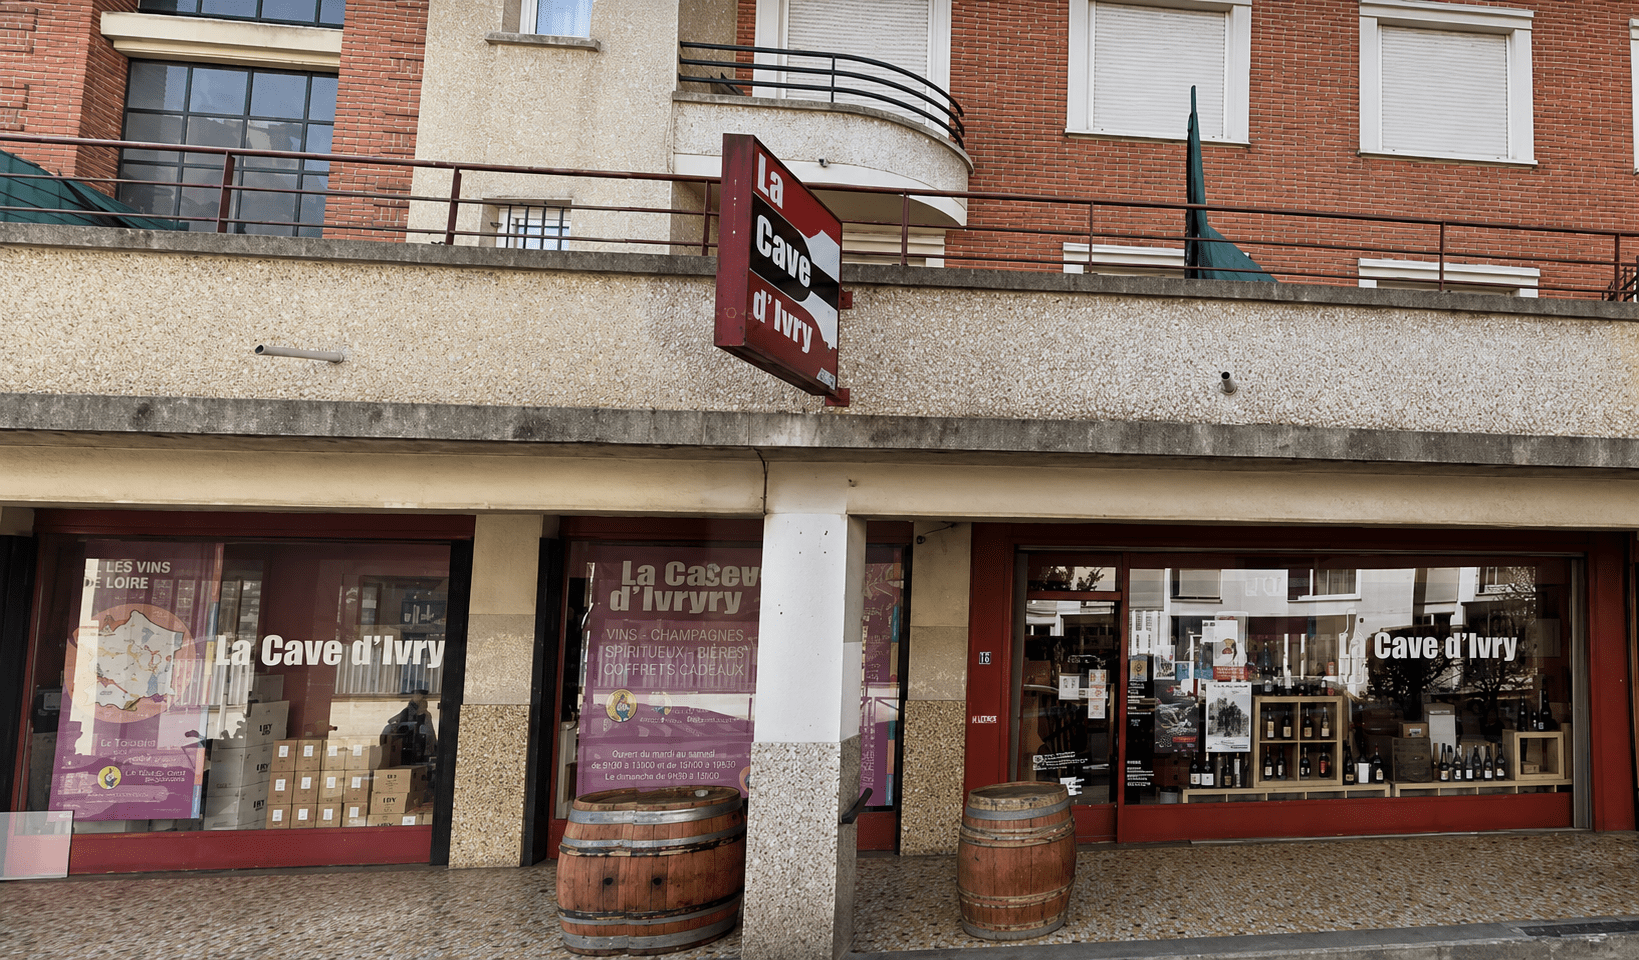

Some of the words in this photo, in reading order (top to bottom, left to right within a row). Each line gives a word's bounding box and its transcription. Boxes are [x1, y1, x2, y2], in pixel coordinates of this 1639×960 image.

[757, 152, 784, 210] La
[756, 214, 811, 288] Cave
[753, 289, 813, 354] d'Ivry
[106, 561, 133, 573] LES
[136, 561, 171, 574] VINS
[621, 560, 656, 586] La
[106, 576, 149, 589] LOIRE
[610, 586, 743, 615] d'Ivryry
[606, 628, 638, 641] VINS
[650, 628, 744, 641] CHAMPAGNES
[215, 634, 251, 666] La
[261, 634, 343, 667] Cave
[351, 635, 445, 669] d'Ivry
[605, 645, 684, 659] SPIRITUEUX
[697, 643, 744, 659] BIÈRES
[1339, 632, 1366, 658] La
[1374, 632, 1439, 659] Cave
[1445, 632, 1518, 662] d'Ivry
[980, 652, 990, 664] 16
[604, 663, 676, 676] COFFRETS
[679, 663, 744, 676] CADEAUX
[640, 749, 650, 758] du
[605, 771, 615, 780] Le
